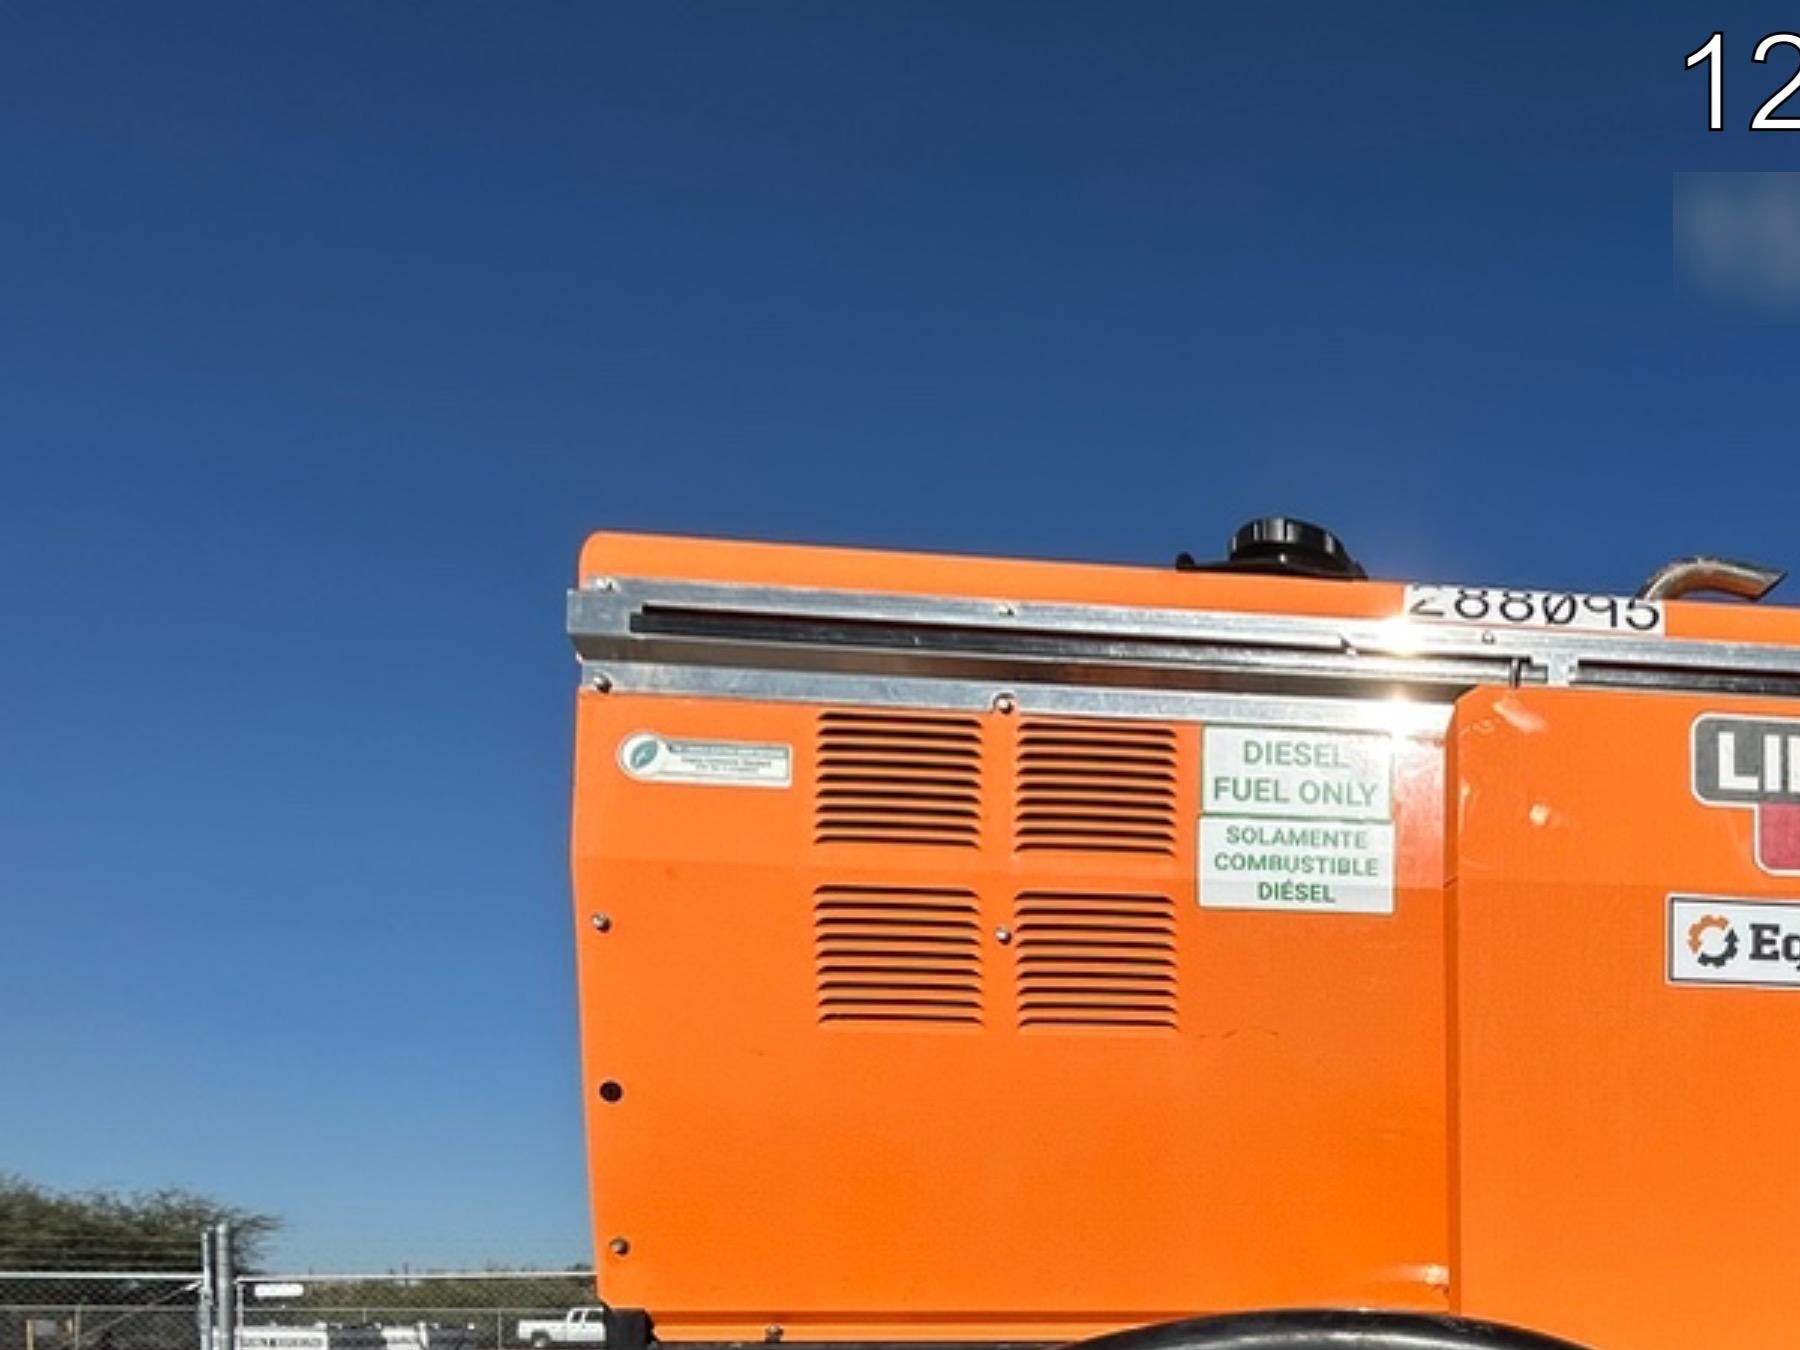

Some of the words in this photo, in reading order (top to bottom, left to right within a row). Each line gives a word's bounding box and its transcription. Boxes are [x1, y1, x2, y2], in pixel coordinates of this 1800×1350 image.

[1243, 740, 1350, 769] DIESEL
[1213, 776, 1290, 804] FUEL
[1299, 779, 1378, 807] ONLY
[1226, 824, 1369, 850] SOLAMENTE
[1213, 851, 1379, 877] COMBUSTIBLE
[1257, 878, 1337, 904] DIÉSEL
